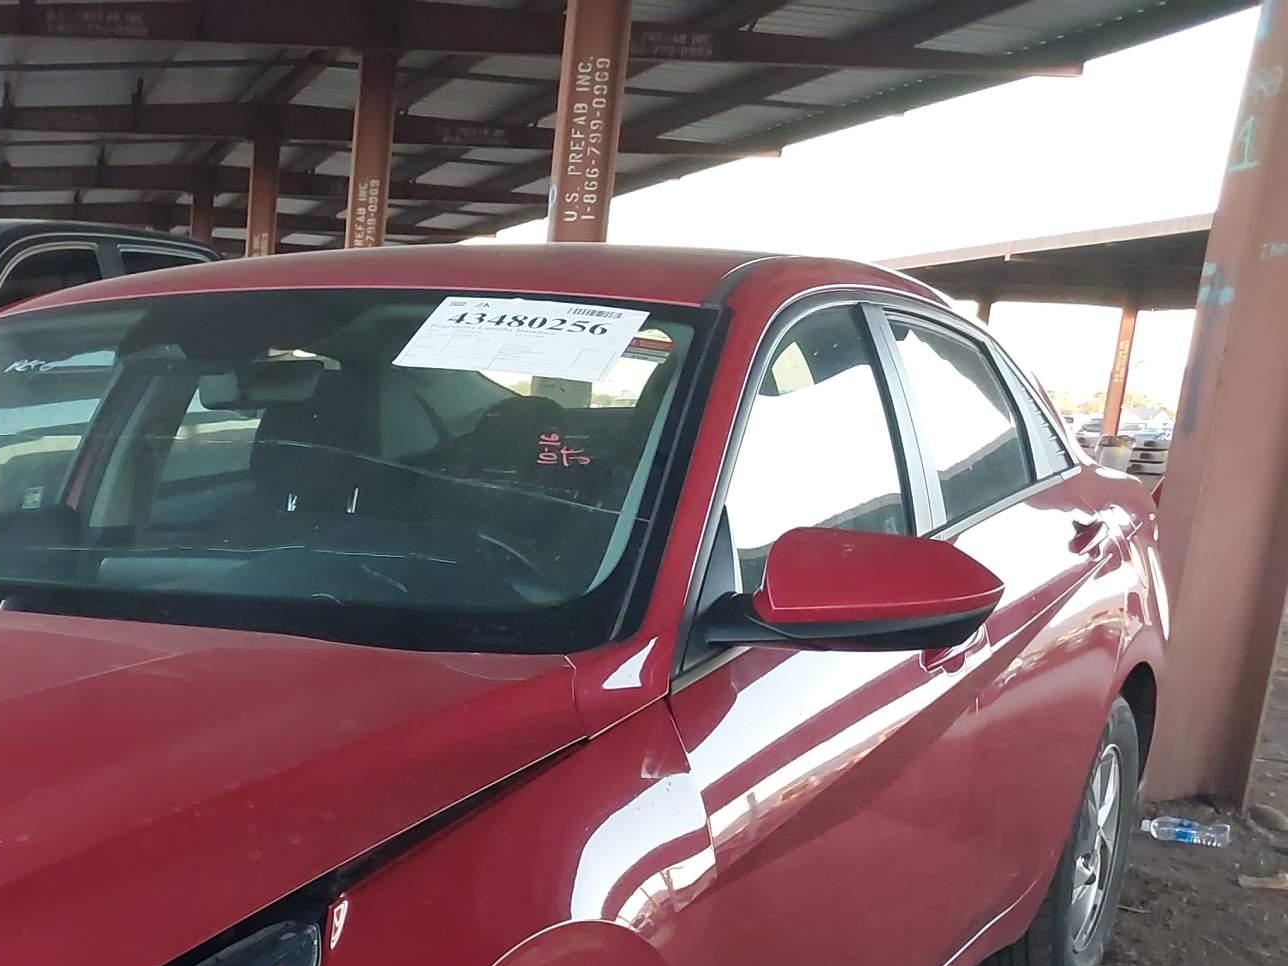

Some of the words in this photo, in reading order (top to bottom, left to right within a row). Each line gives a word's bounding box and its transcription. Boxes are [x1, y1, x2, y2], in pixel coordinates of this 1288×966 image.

[568, 102, 589, 176] PREFAB
[581, 57, 611, 220] 1-866-799-0969
[563, 187, 581, 222] U.S.
[448, 312, 610, 336] 43480256
[536, 433, 561, 464] 10-16
